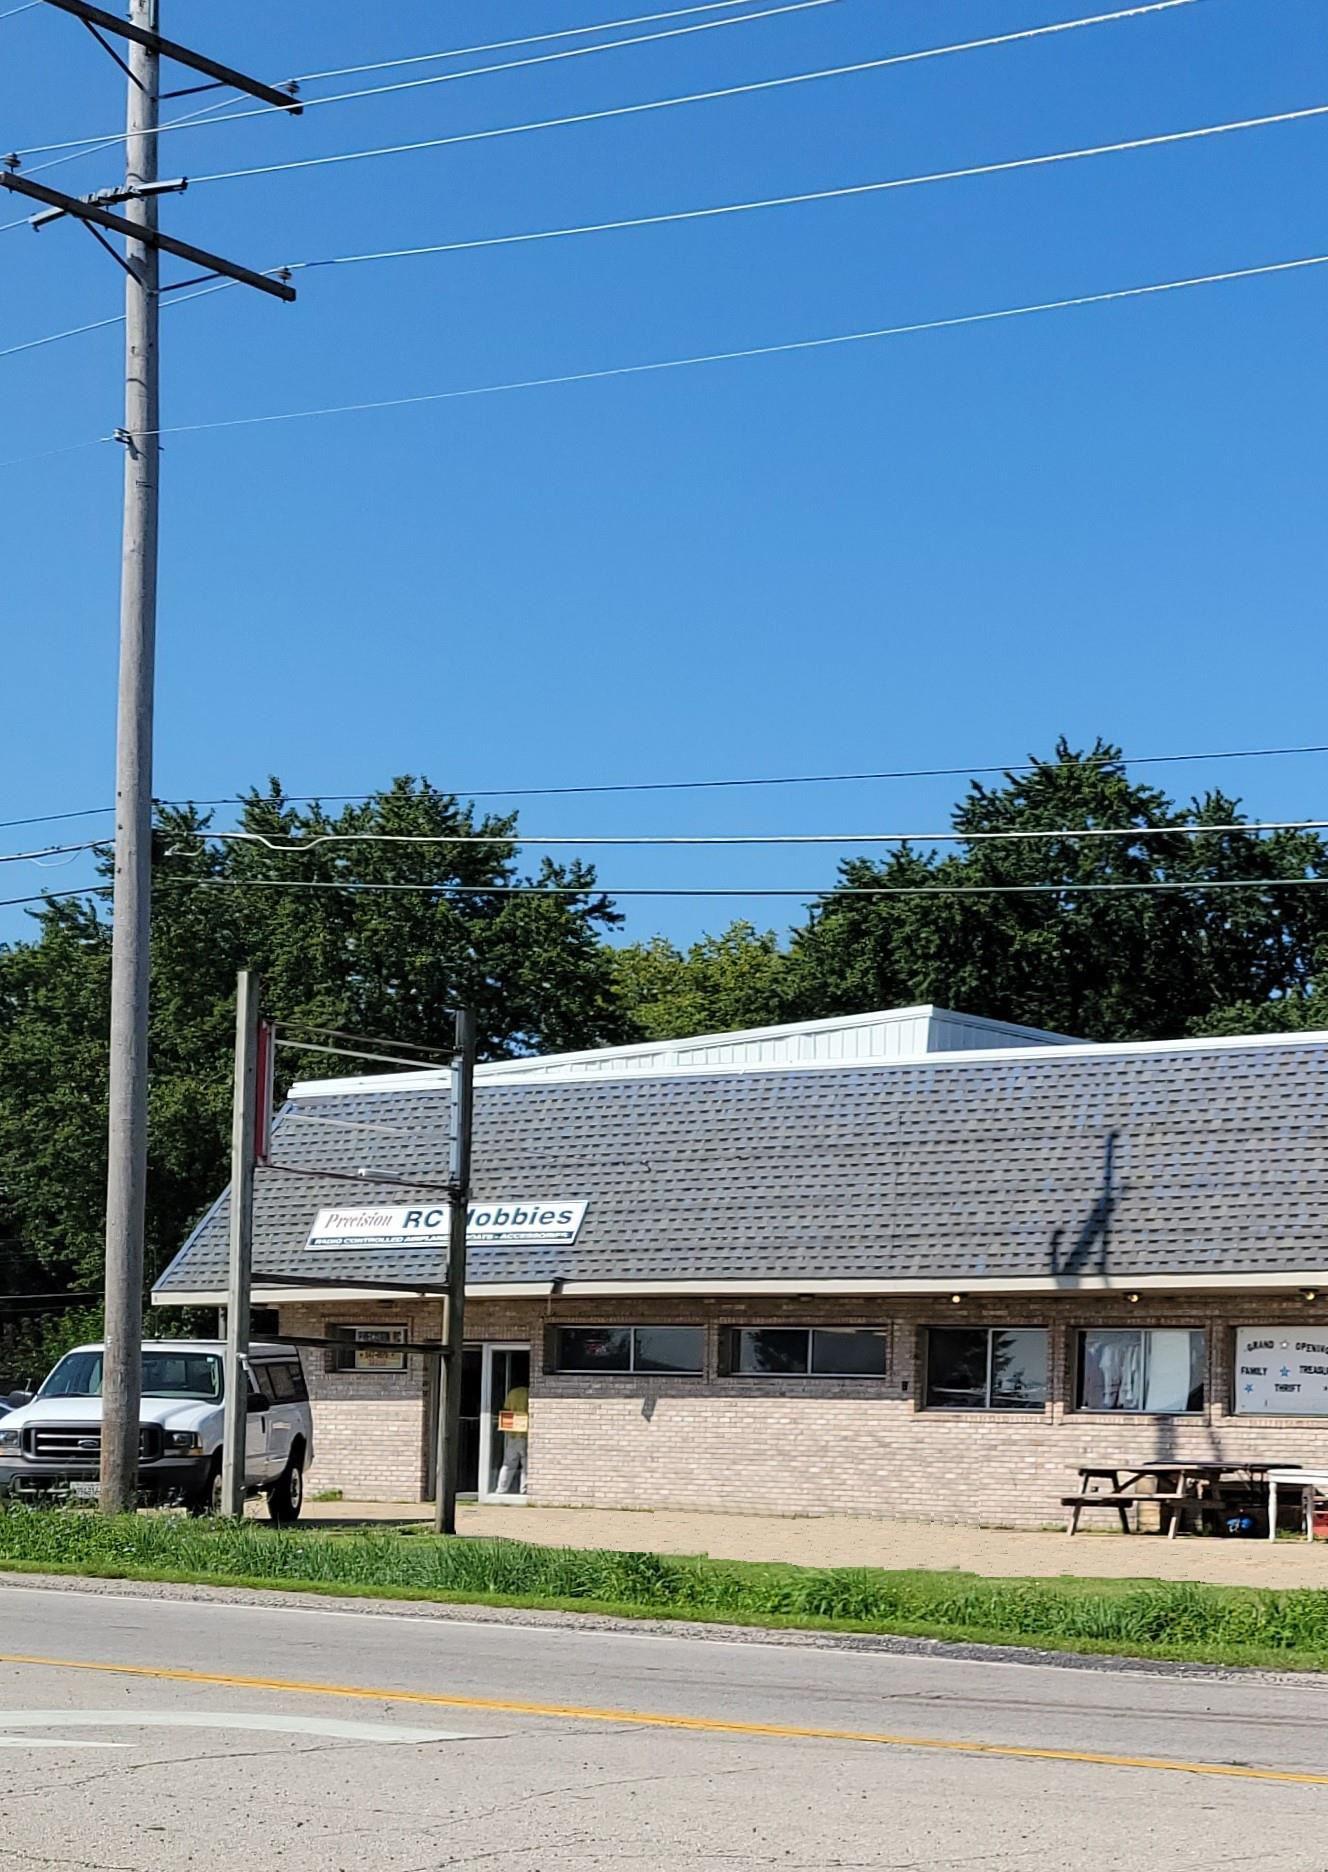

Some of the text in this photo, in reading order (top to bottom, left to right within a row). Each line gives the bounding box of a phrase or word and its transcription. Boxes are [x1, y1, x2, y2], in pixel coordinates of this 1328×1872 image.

[325, 1211, 393, 1229] Precision
[402, 1209, 444, 1229] RC
[1246, 1340, 1275, 1352] GRAND
[1240, 1366, 1268, 1376] FAMILY
[1274, 1383, 1302, 1393] THRIFT
